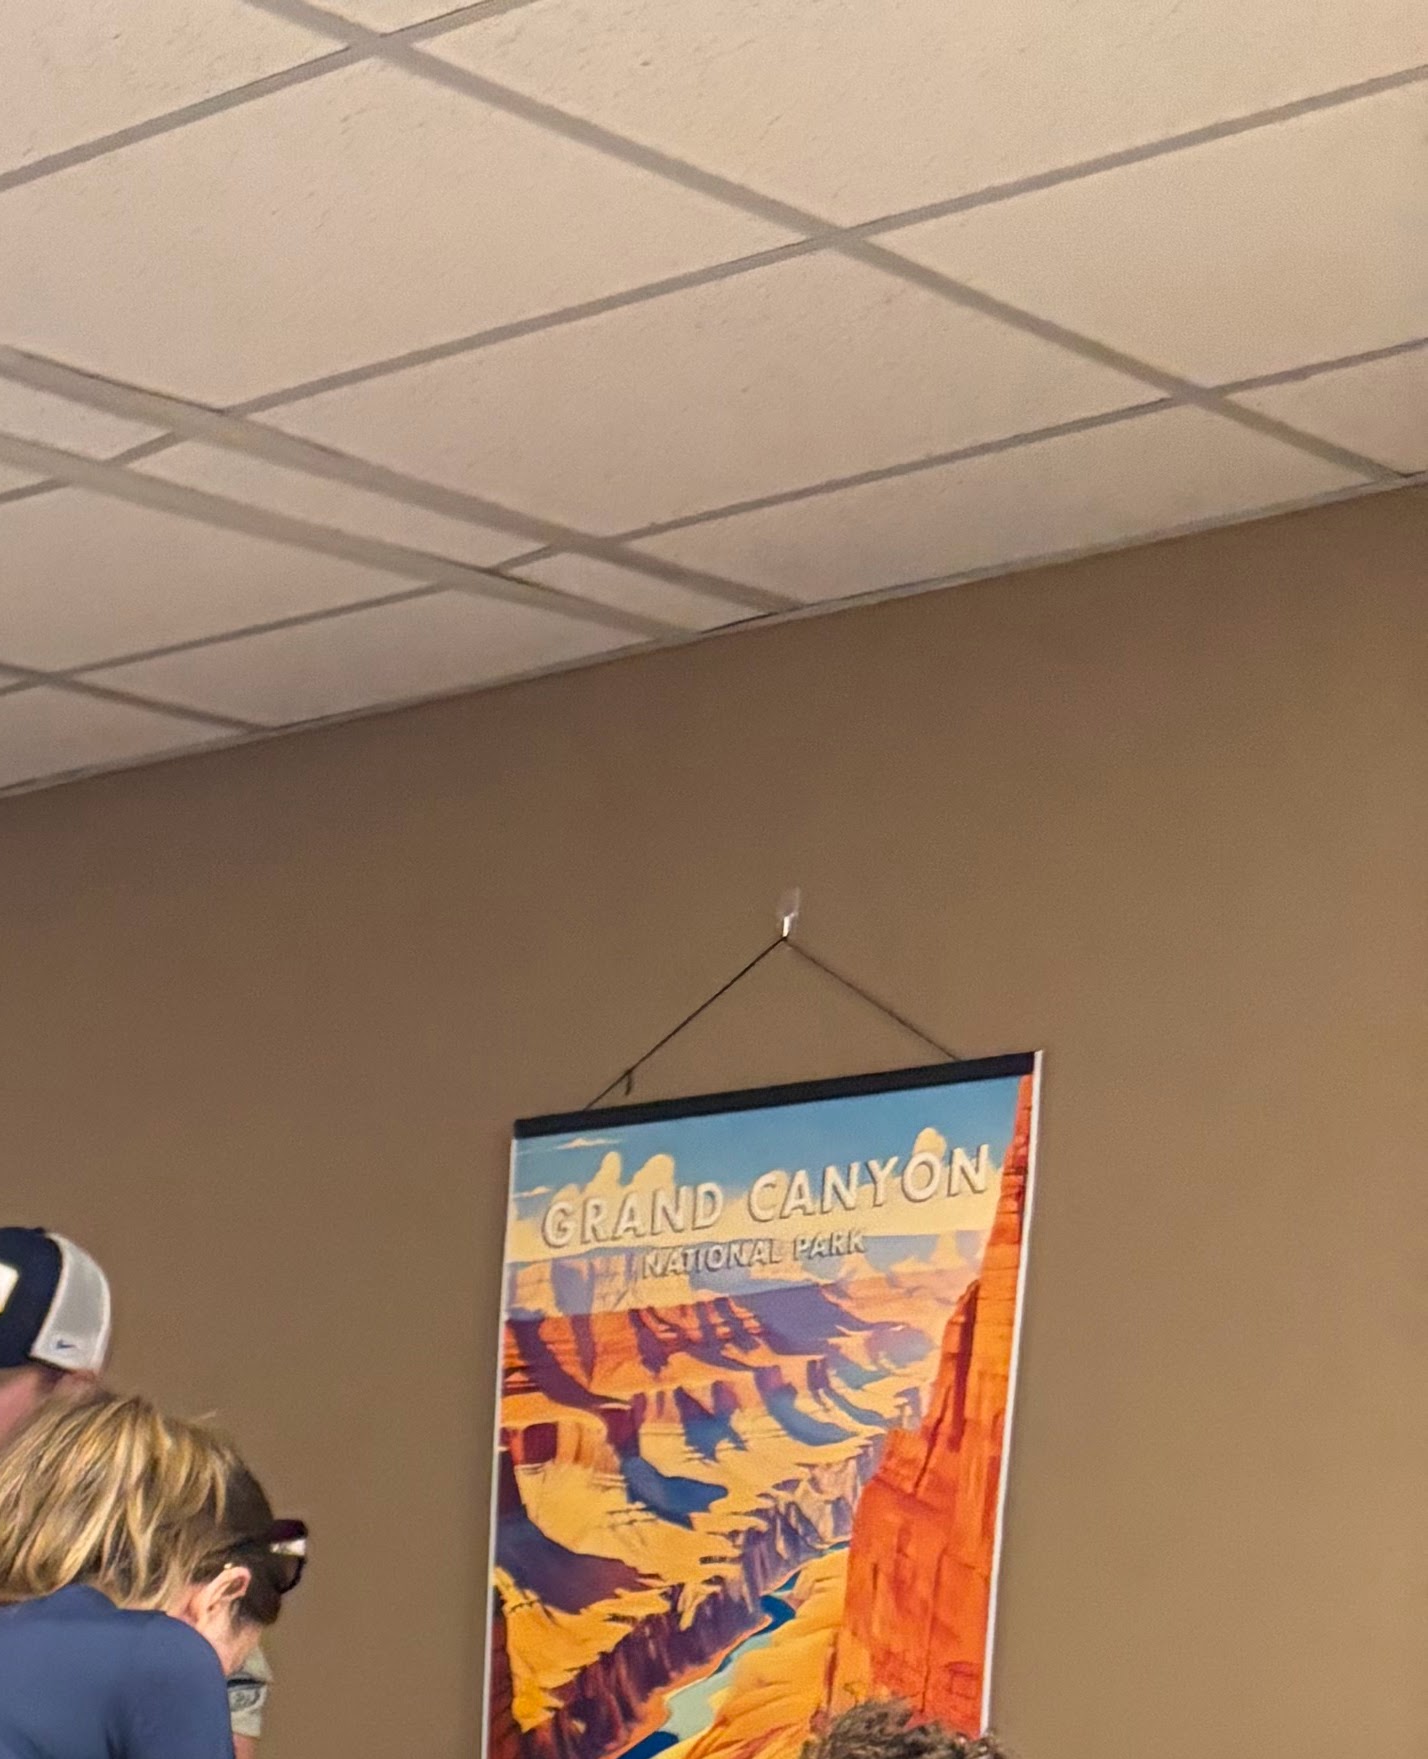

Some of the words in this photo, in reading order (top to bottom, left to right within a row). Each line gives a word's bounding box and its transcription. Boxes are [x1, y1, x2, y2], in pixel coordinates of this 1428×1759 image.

[542, 1181, 724, 1249] GRAND
[747, 1143, 991, 1222] CANYON
[641, 1238, 782, 1280] NATIONAL
[793, 1228, 868, 1260] PARK
